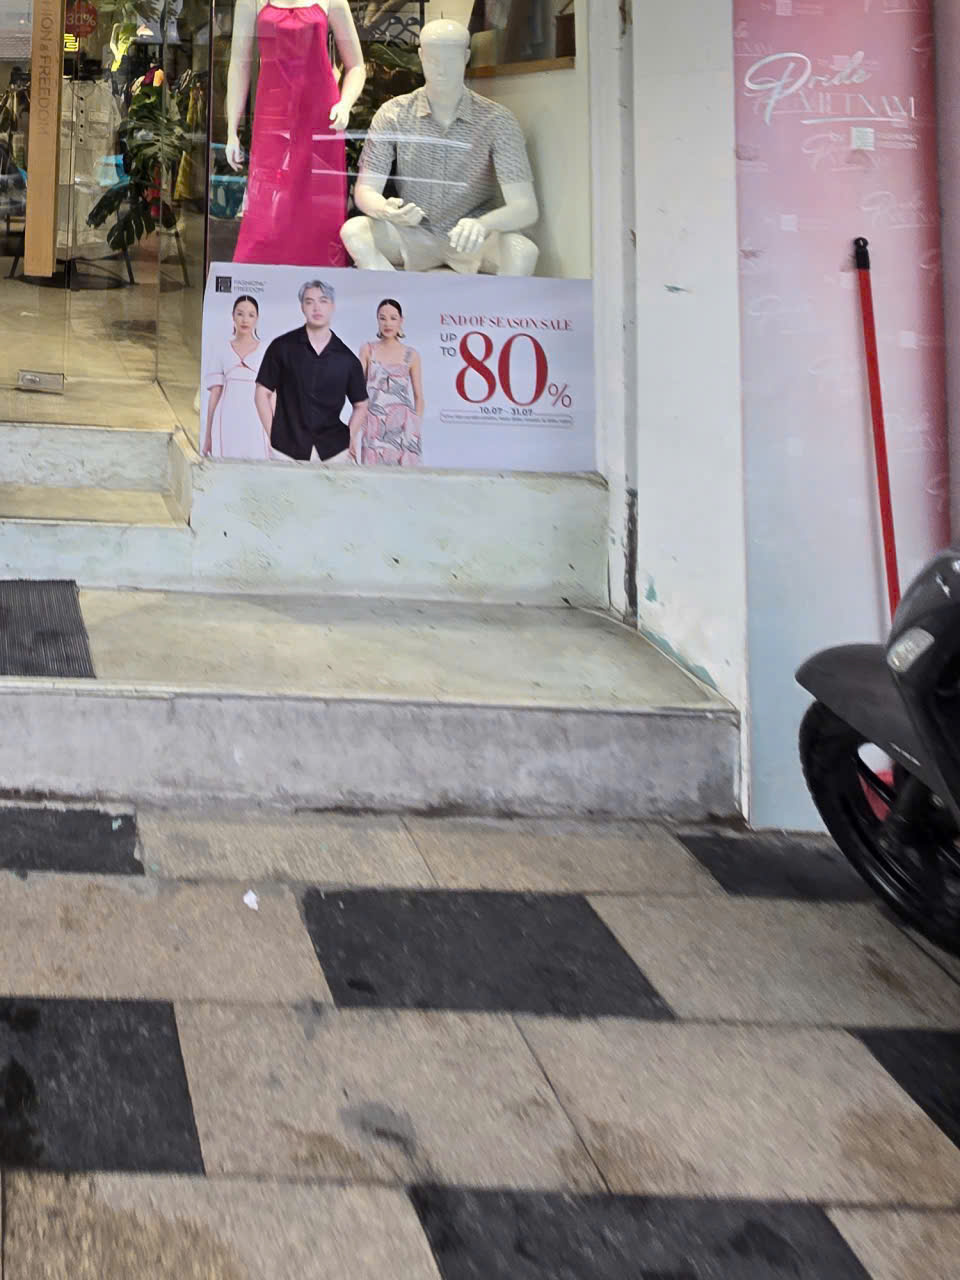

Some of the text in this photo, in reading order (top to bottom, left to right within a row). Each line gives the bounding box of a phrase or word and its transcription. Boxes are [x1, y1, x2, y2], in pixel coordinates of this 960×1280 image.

[440, 313, 574, 331] END OF SEASON SALE
[440, 332, 458, 343] UP
[440, 346, 457, 358] TO
[455, 330, 572, 409] 80%
[479, 406, 504, 415] 10.07
[510, 407, 533, 417] 31.07
